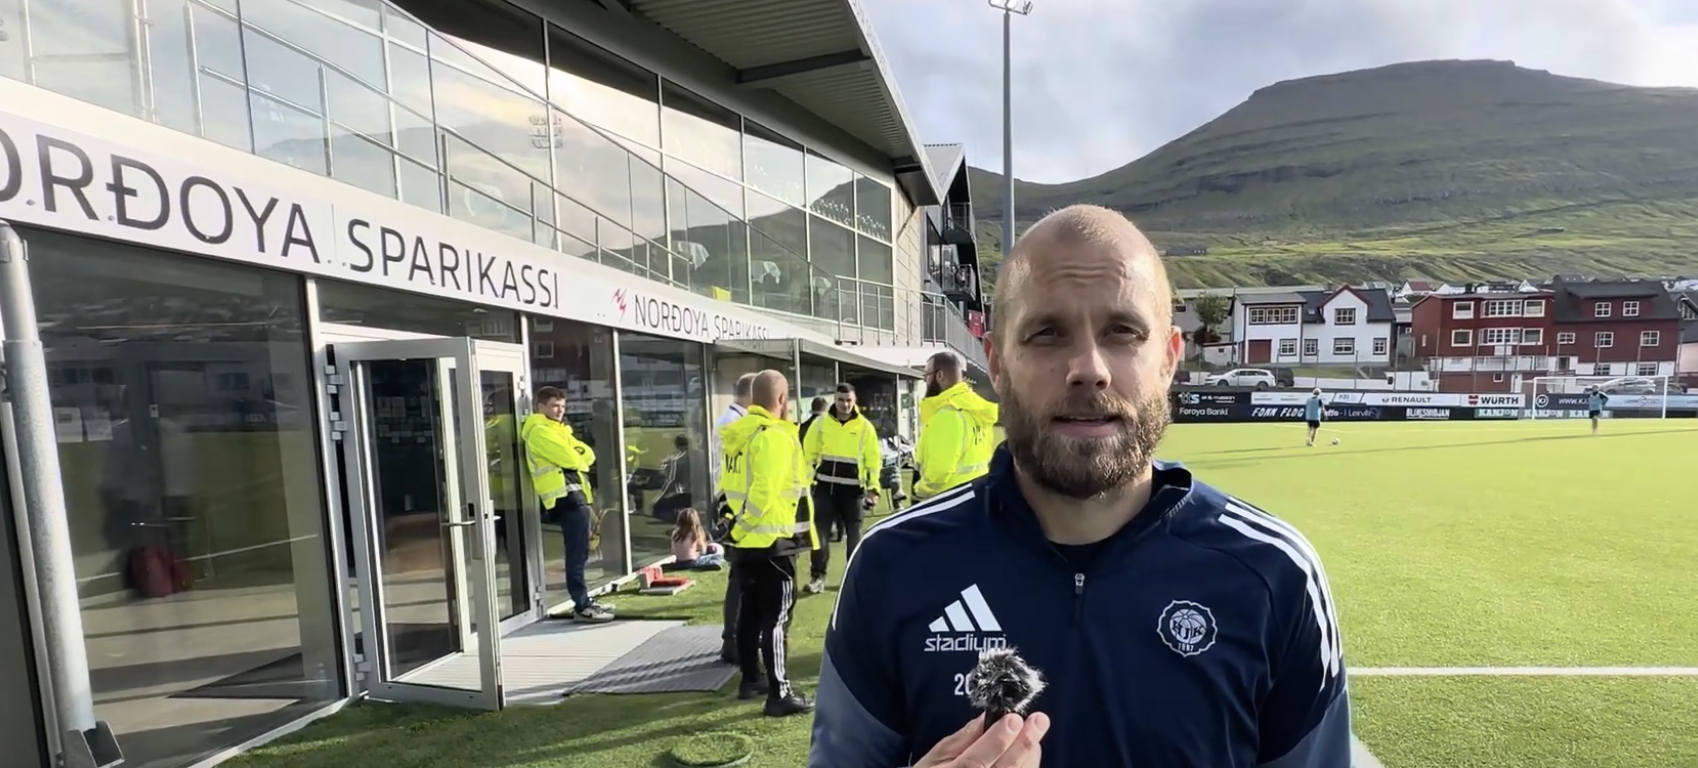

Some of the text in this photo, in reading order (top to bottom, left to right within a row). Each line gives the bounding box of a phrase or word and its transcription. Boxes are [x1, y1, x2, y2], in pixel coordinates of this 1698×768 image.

[347, 218, 559, 310] SPARIKASSI
[634, 294, 710, 337] NORÐOYA
[1481, 396, 1519, 405] WÜRTH
[1206, 407, 1229, 416] Banki
[924, 633, 1007, 652] stadium
